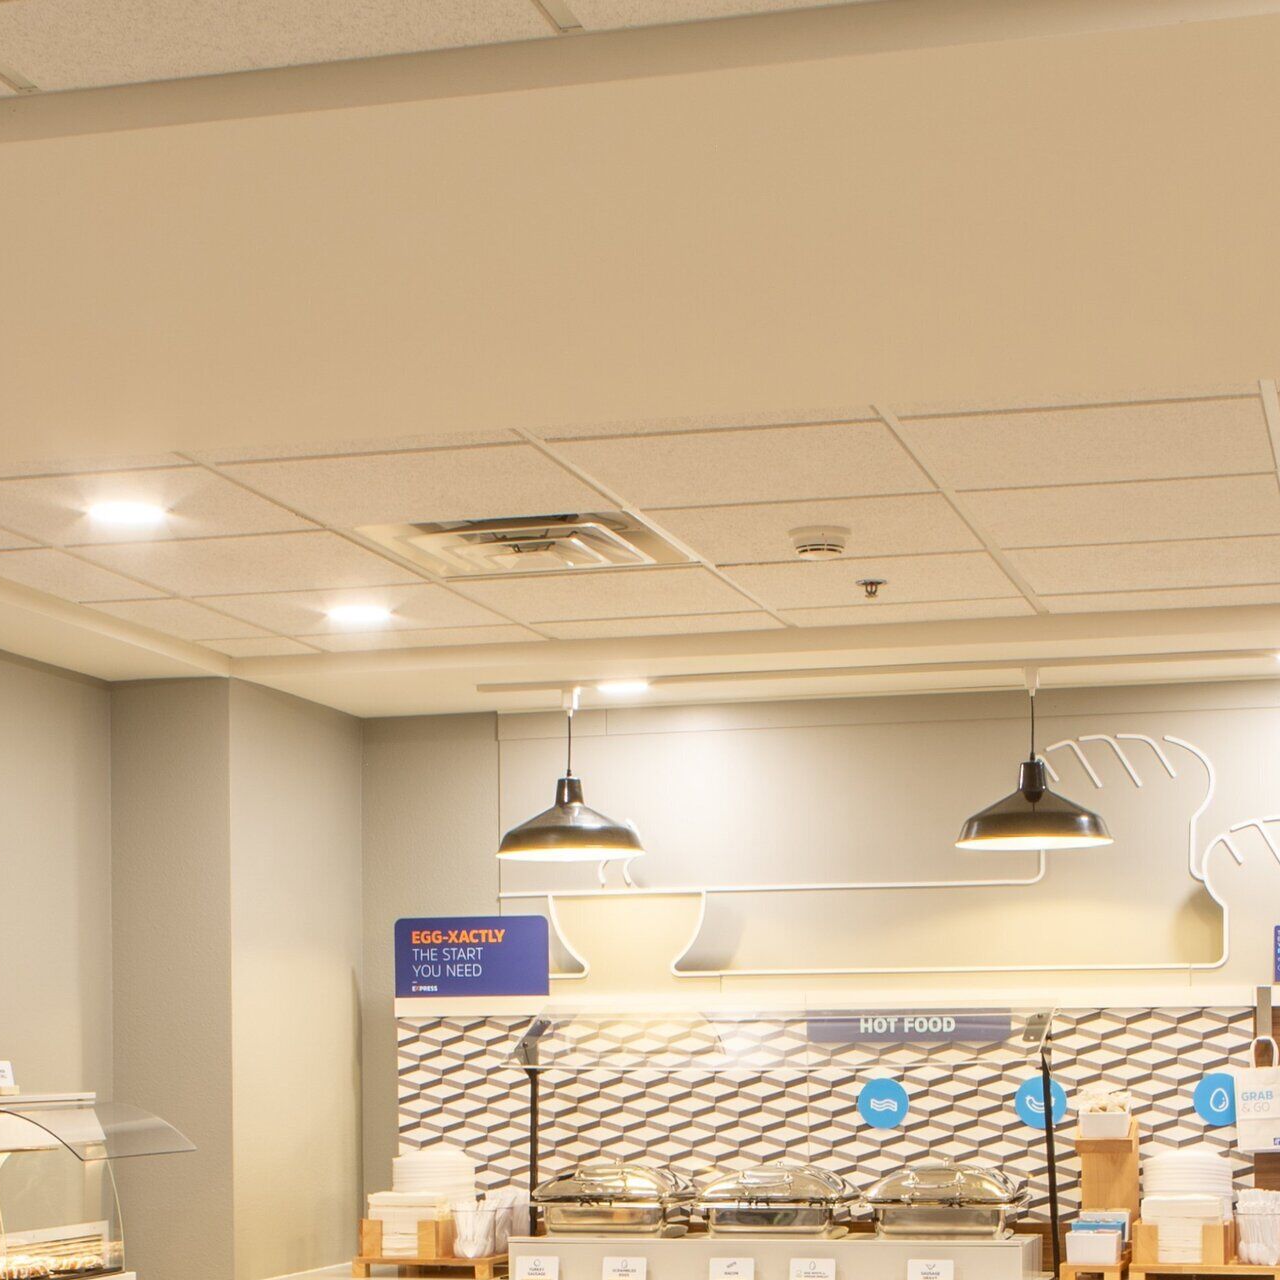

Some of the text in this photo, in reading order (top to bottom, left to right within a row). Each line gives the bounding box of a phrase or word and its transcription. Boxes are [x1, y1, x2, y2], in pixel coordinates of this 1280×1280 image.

[411, 928, 506, 945] EGG-XACTLY
[412, 946, 484, 962] THE START
[411, 962, 483, 978] YOU NEED
[411, 984, 439, 993] EXPRESS
[859, 1015, 957, 1034] HOT FOOD
[1240, 1090, 1274, 1101] GRAB
[1253, 1101, 1271, 1112] GO
